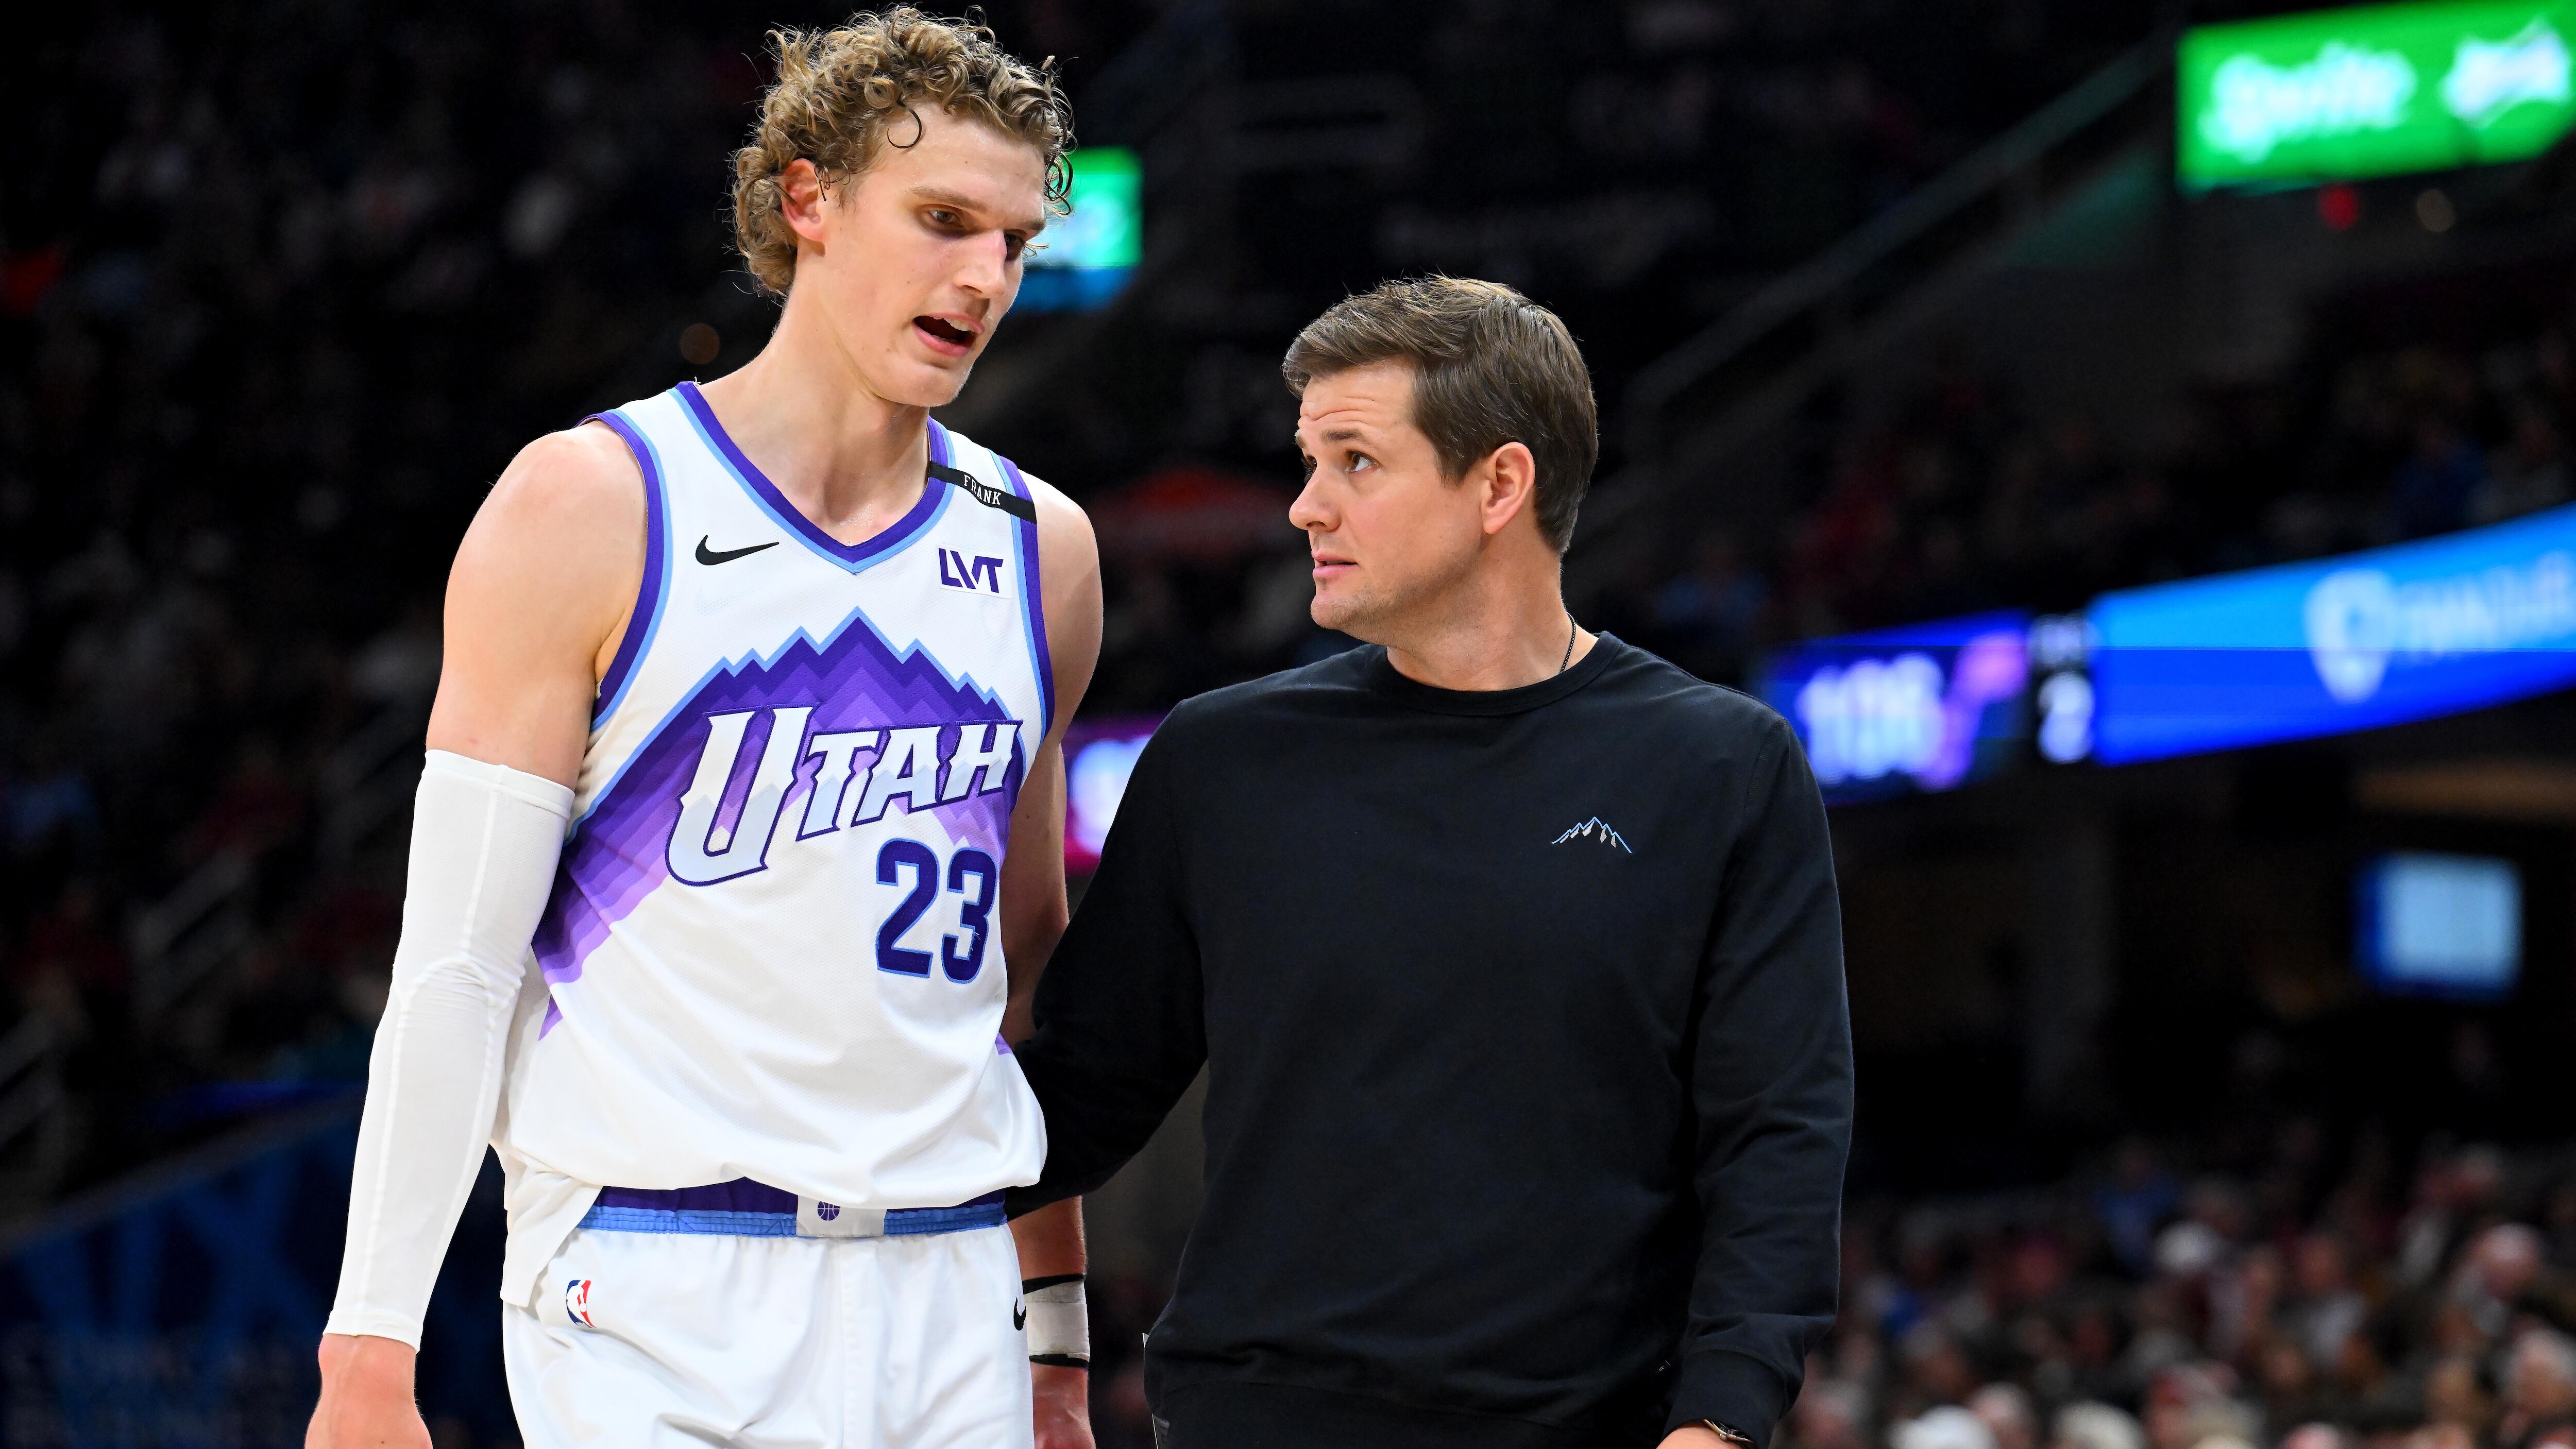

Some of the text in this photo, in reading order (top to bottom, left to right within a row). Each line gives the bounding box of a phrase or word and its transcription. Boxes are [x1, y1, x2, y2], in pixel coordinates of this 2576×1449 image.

[963, 474, 1001, 505] FRANK
[938, 548, 1004, 593] LVT
[665, 702, 1023, 887] UTAH
[876, 838, 998, 984] 23
